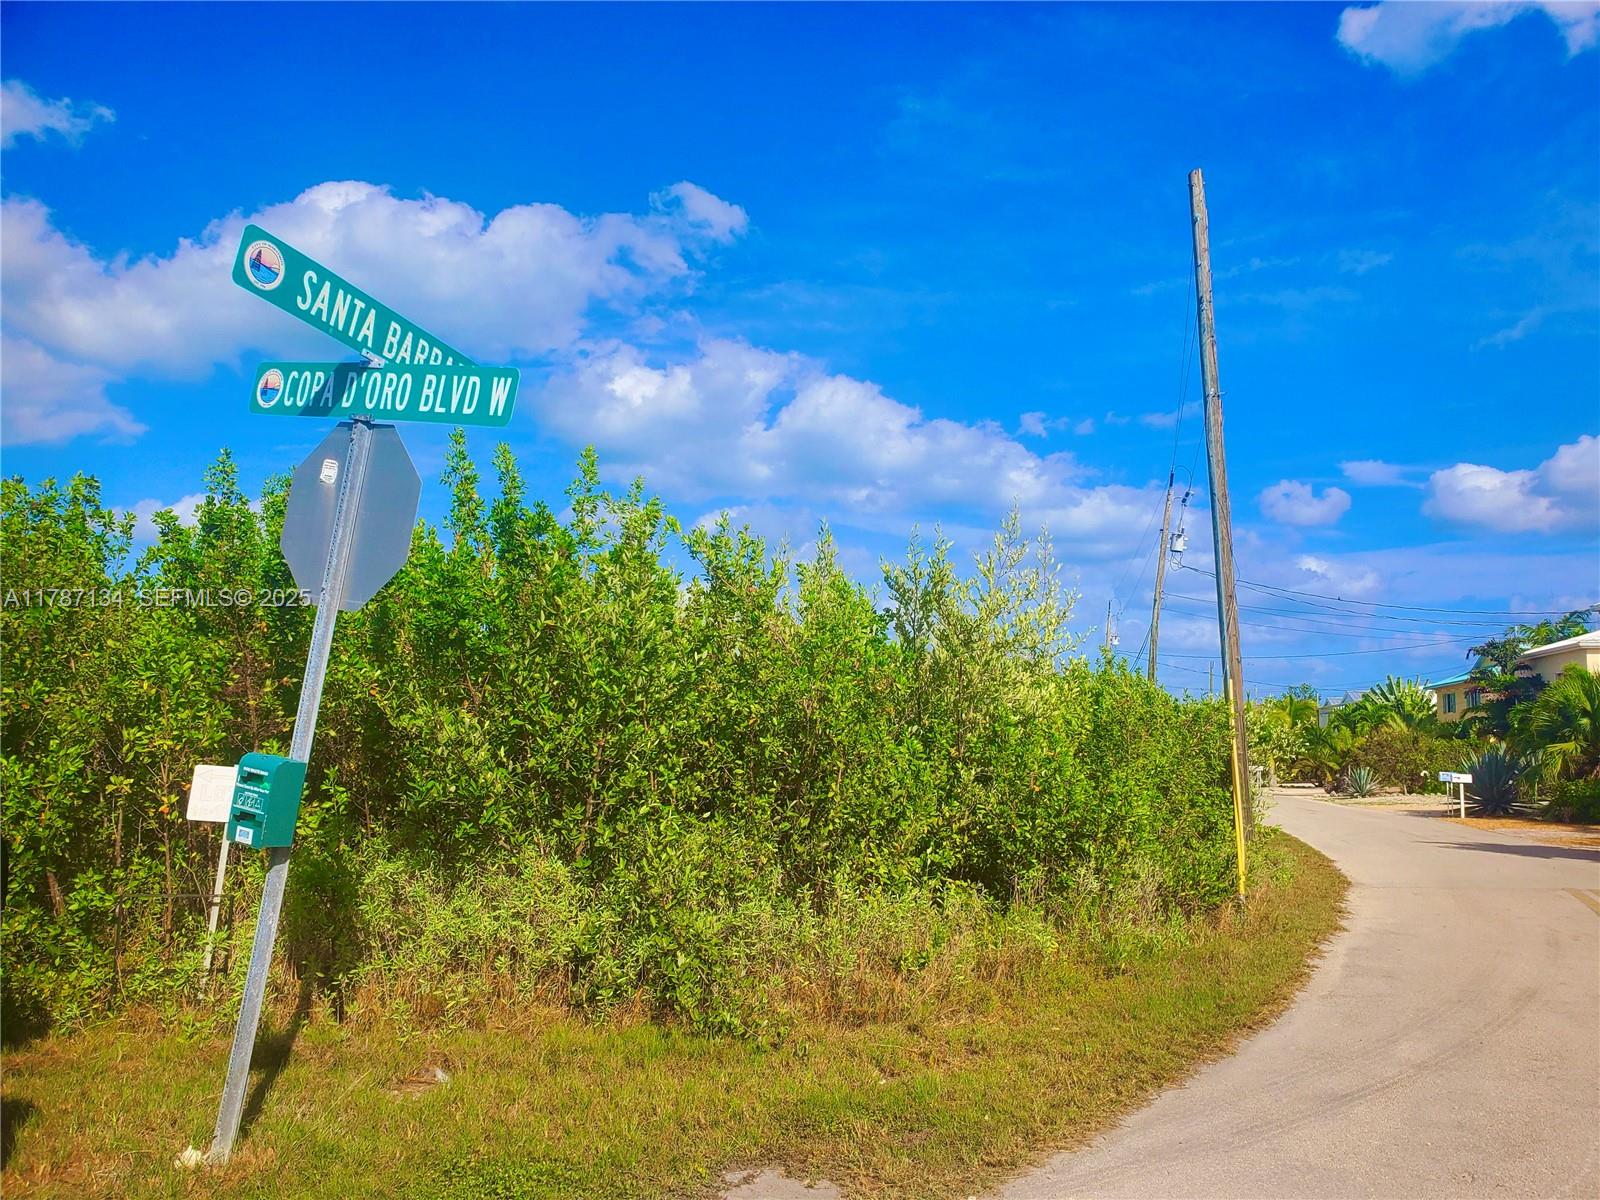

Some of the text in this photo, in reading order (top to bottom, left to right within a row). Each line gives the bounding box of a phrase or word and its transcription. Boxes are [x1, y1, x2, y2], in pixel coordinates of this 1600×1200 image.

[296, 270, 377, 348] SANTA
[283, 371, 512, 417] COPA D'ORO BLVD W
